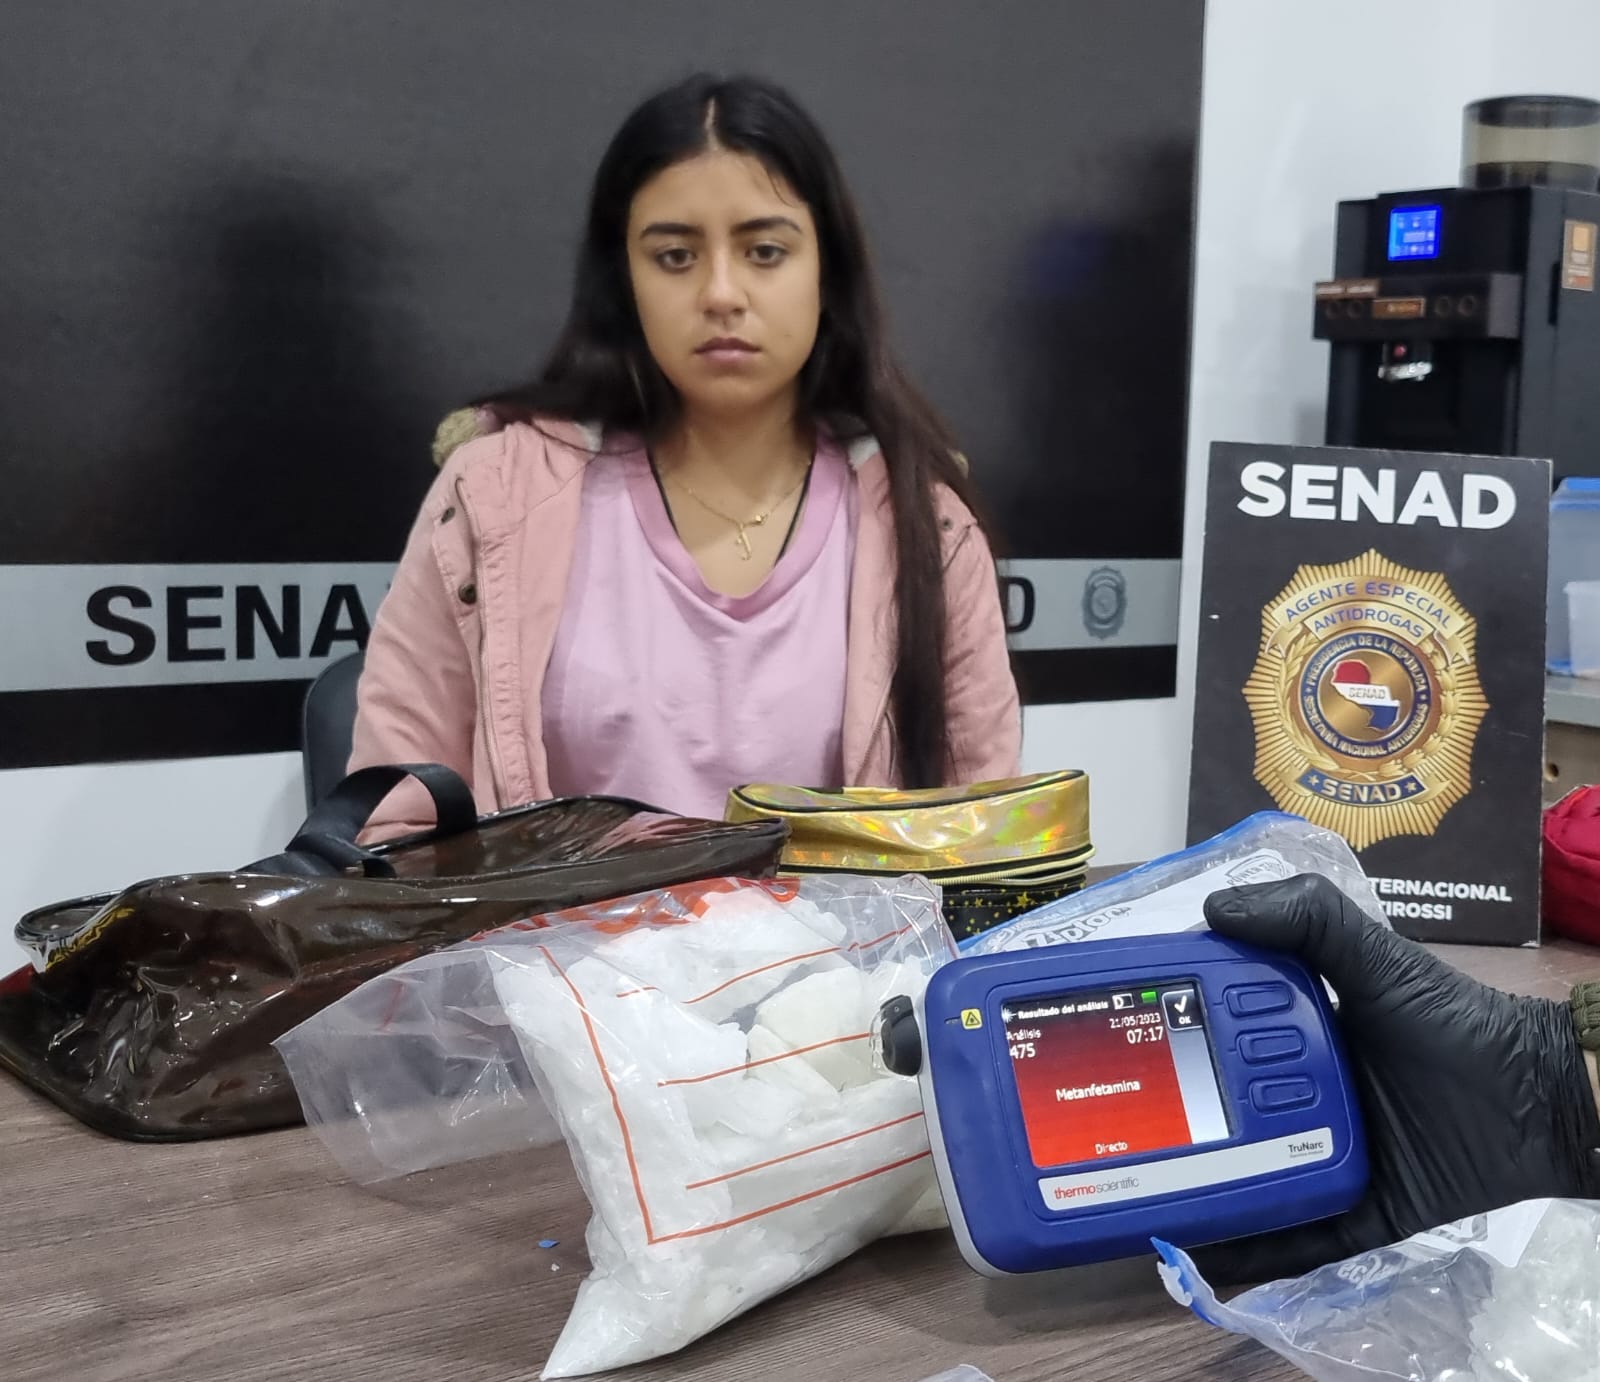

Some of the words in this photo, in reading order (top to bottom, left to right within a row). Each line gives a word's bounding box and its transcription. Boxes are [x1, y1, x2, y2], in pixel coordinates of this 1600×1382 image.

[1236, 461, 1517, 530] SENAD
[1285, 582, 1357, 623] AGENTE
[1365, 581, 1451, 629] ESPECIAL
[85, 583, 392, 666] SENA
[1314, 608, 1425, 638] ANTIDROGAS
[1358, 635, 1373, 646] DE
[1374, 637, 1389, 650] LA
[1348, 687, 1386, 699] SENAD
[1321, 779, 1401, 802] SENAD
[1357, 876, 1513, 902] TERNACIONAL
[1018, 1005, 1060, 1020] Resultado
[1109, 1012, 1162, 1029] 21/05/2023
[1178, 1015, 1193, 1025] OK
[1126, 1026, 1165, 1044] 07:17
[1009, 1043, 1036, 1059] 475
[1055, 1080, 1141, 1102] Metanfetamina
[1095, 1141, 1128, 1155] Directo
[1288, 1141, 1324, 1153] TruNarc
